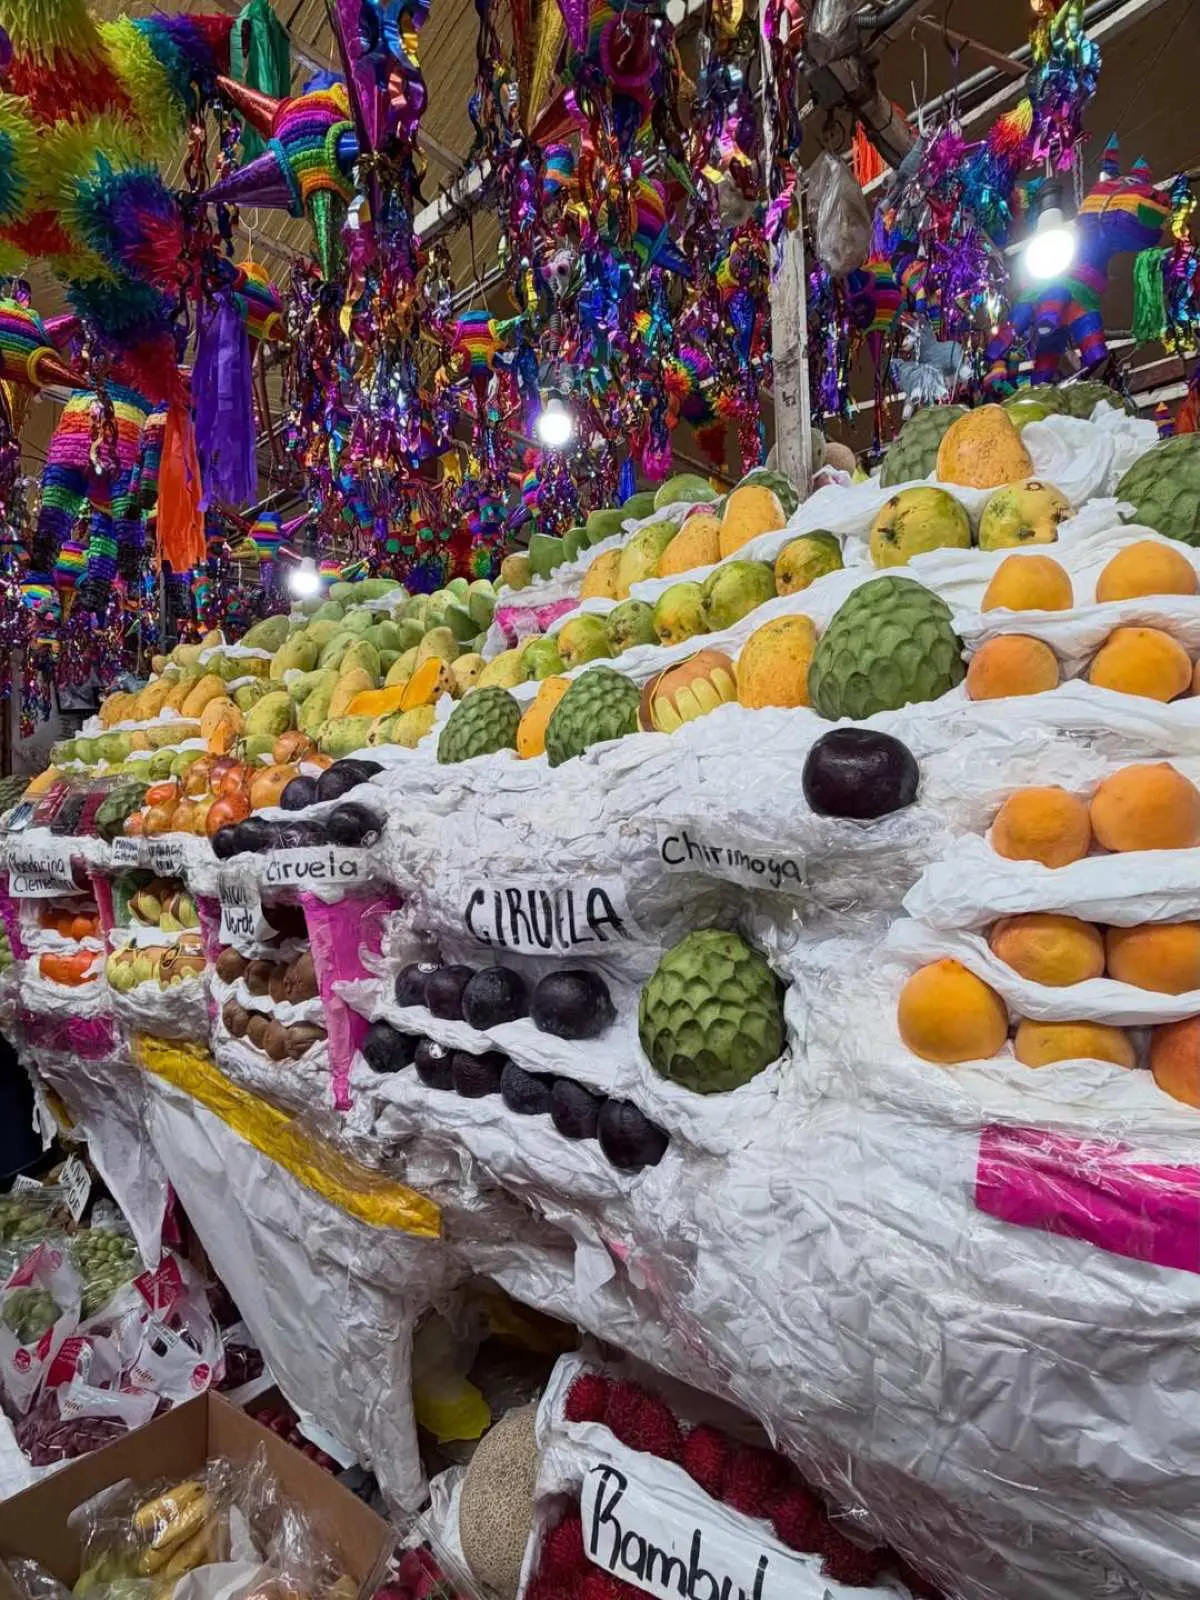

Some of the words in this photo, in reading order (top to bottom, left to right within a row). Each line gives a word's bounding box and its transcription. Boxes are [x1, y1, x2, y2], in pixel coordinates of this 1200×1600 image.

[266, 851, 358, 881] Ciruela
[661, 831, 804, 888] Chirimoya
[465, 887, 634, 948] CIRUELA
